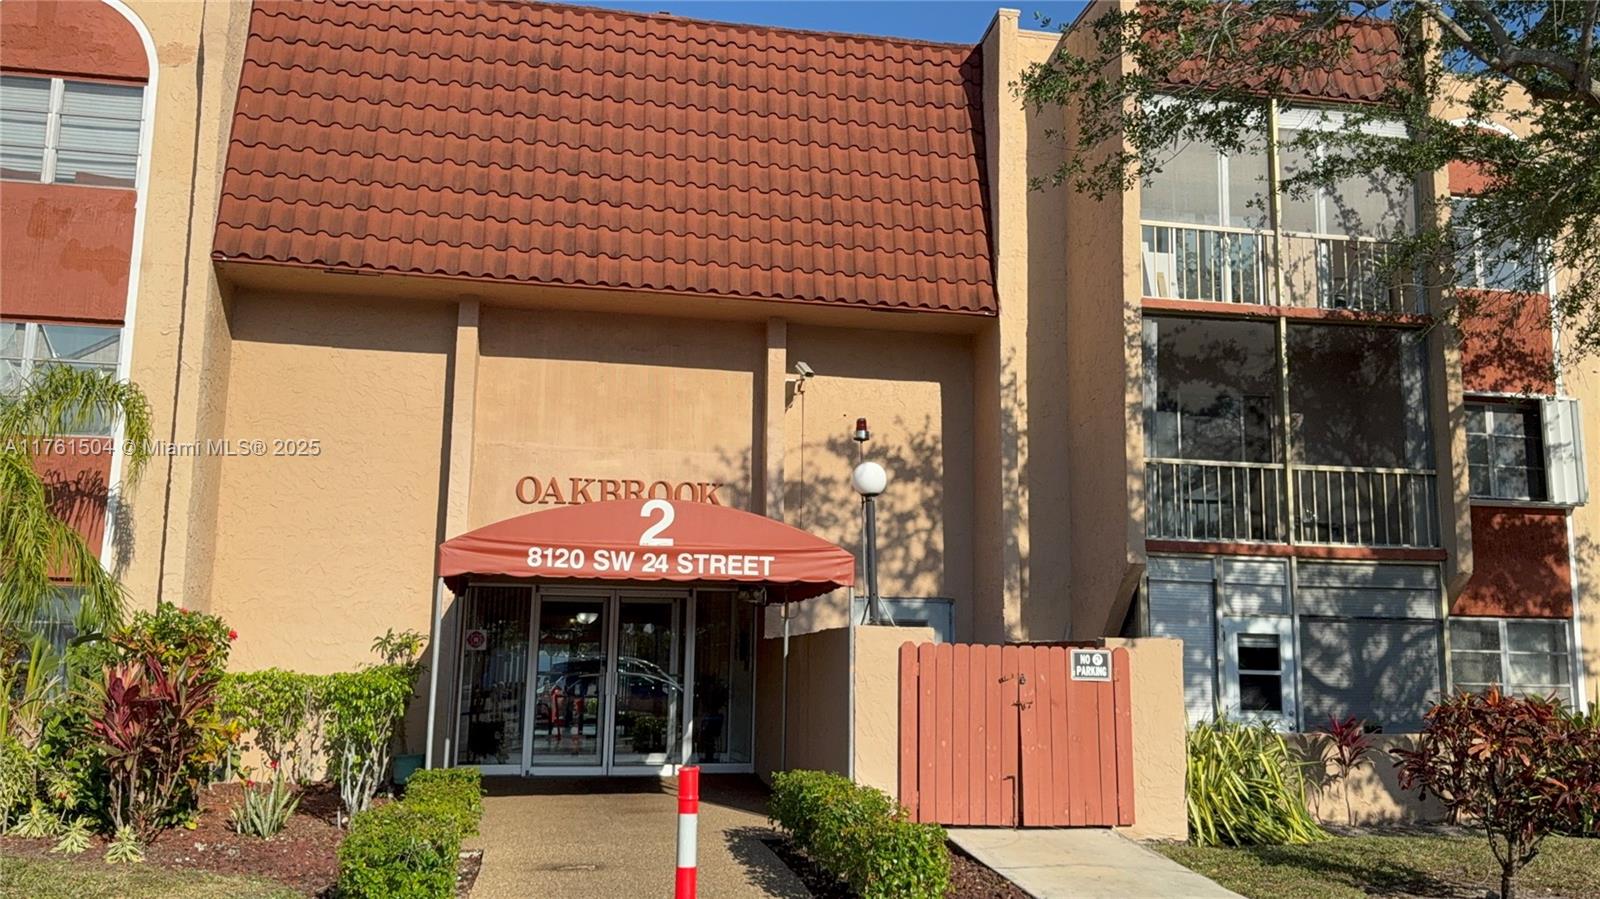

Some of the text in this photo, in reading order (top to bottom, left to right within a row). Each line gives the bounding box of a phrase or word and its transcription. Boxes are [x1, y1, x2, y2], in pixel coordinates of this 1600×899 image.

[515, 476, 724, 506] OAKBROOK
[639, 499, 675, 547] 2
[527, 547, 775, 577] 8120 SW 24 STREET
[1076, 666, 1107, 677] PARKING
[1080, 654, 1090, 665] NO
